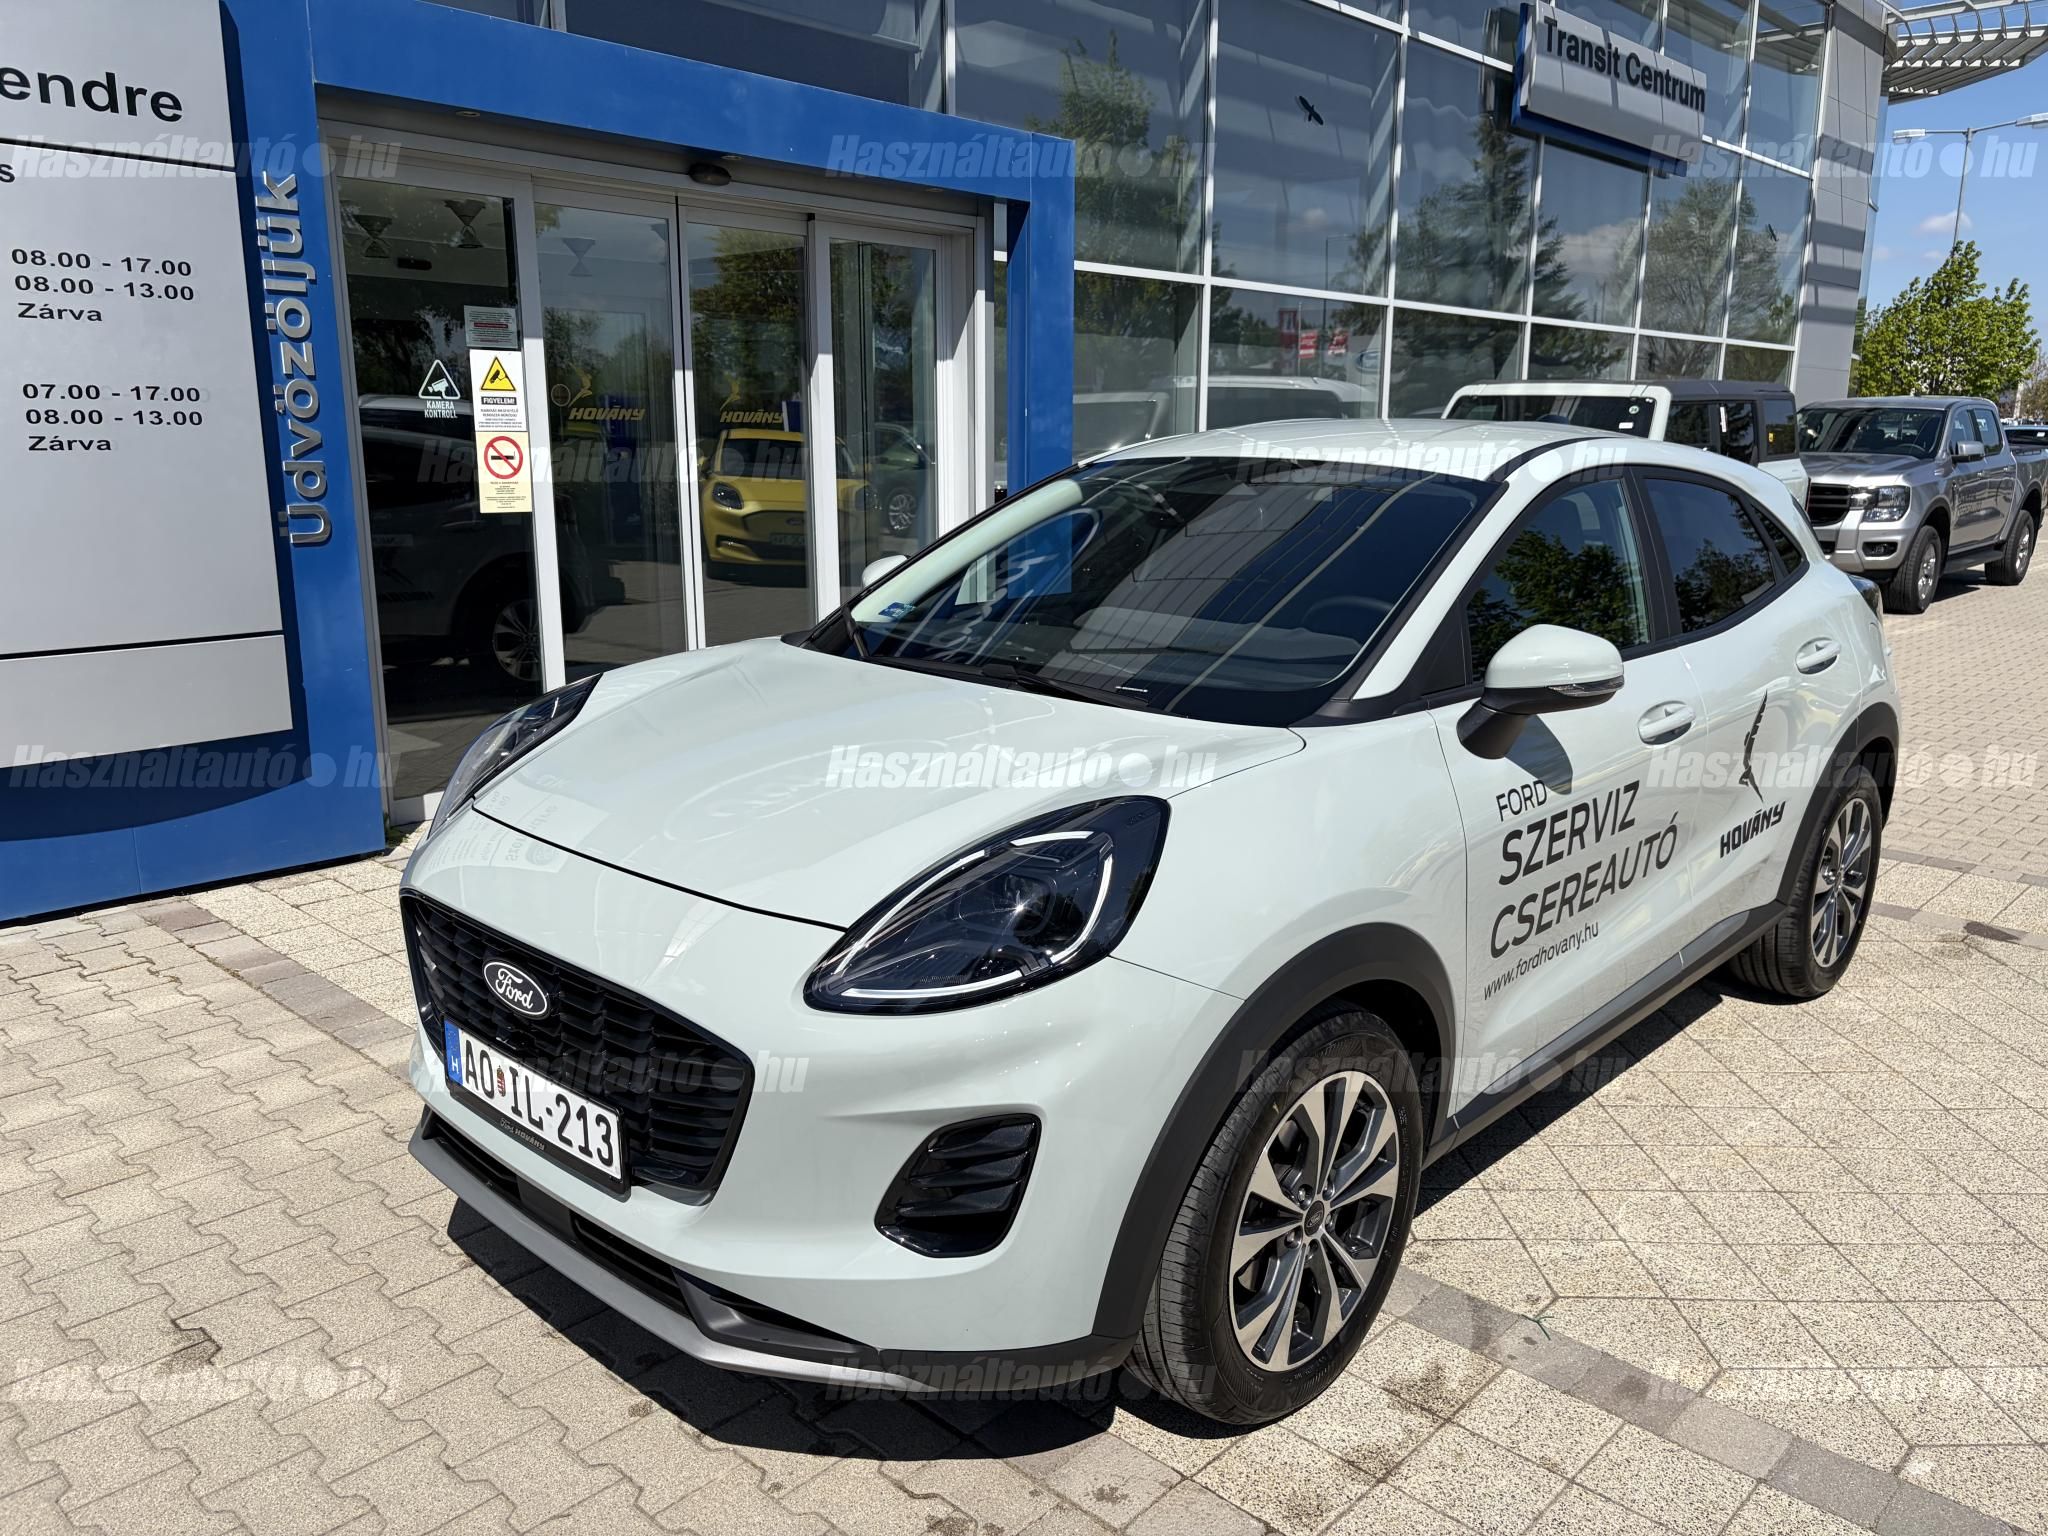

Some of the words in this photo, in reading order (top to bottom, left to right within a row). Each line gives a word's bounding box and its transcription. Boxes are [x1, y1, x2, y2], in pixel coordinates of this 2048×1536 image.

[1544, 16, 1620, 78] Transit
[1625, 52, 1706, 113] Centrum
[11, 249, 91, 269] 08.00
[121, 257, 192, 276] 17.00
[14, 275, 94, 294] 08.00
[124, 282, 194, 300] 13.00
[18, 303, 103, 321] Zárva
[255, 170, 333, 544] Üdvözöljük
[22, 383, 101, 400] 07.00
[131, 386, 200, 401] 17.00
[483, 397, 515, 406] FIGYELEM!
[26, 409, 103, 425] 08.00
[133, 411, 203, 425] 13.00
[425, 410, 457, 418] KONTROLL
[427, 401, 454, 410] KAMERA
[28, 435, 112, 451] Zárva
[1496, 779, 1547, 822] FORD
[1499, 780, 1640, 886] SZERVIZ
[1719, 801, 1785, 858] HOVÁNY
[1490, 811, 1678, 959] CSEREAUTÓ
[1484, 920, 1599, 1000] www.fordhovany.hu
[496, 967, 534, 1009] Ford
[451, 1056, 460, 1075] H
